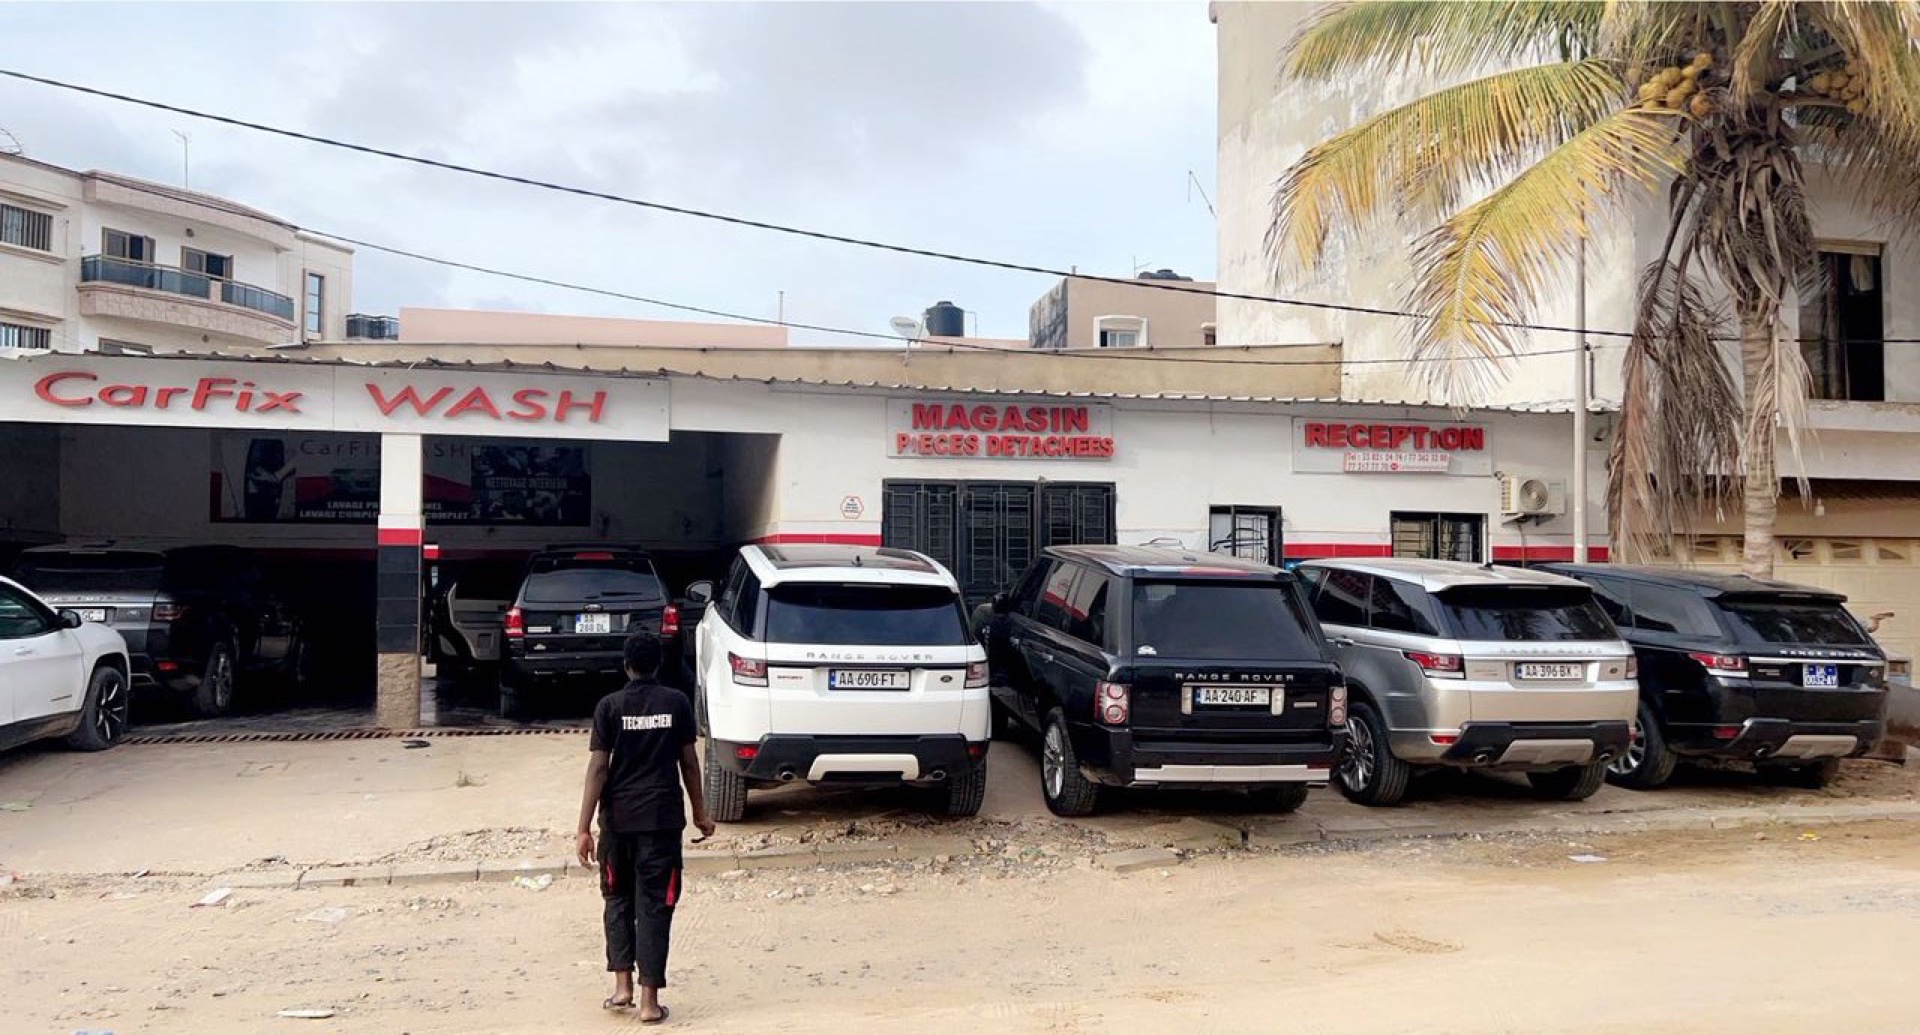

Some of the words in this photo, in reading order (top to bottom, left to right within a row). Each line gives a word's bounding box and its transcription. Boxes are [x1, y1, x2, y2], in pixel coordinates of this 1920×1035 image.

[35, 371, 303, 414] CarFix
[364, 382, 609, 424] WASH
[912, 403, 1089, 433] MAGASIN
[986, 434, 1115, 457] DETACHEES
[806, 651, 865, 660] RANGE
[875, 653, 934, 661] ROVER
[1175, 672, 1231, 681] RANGE
[1241, 674, 1295, 682] ROVER
[622, 714, 673, 730] TECHNICIEN
